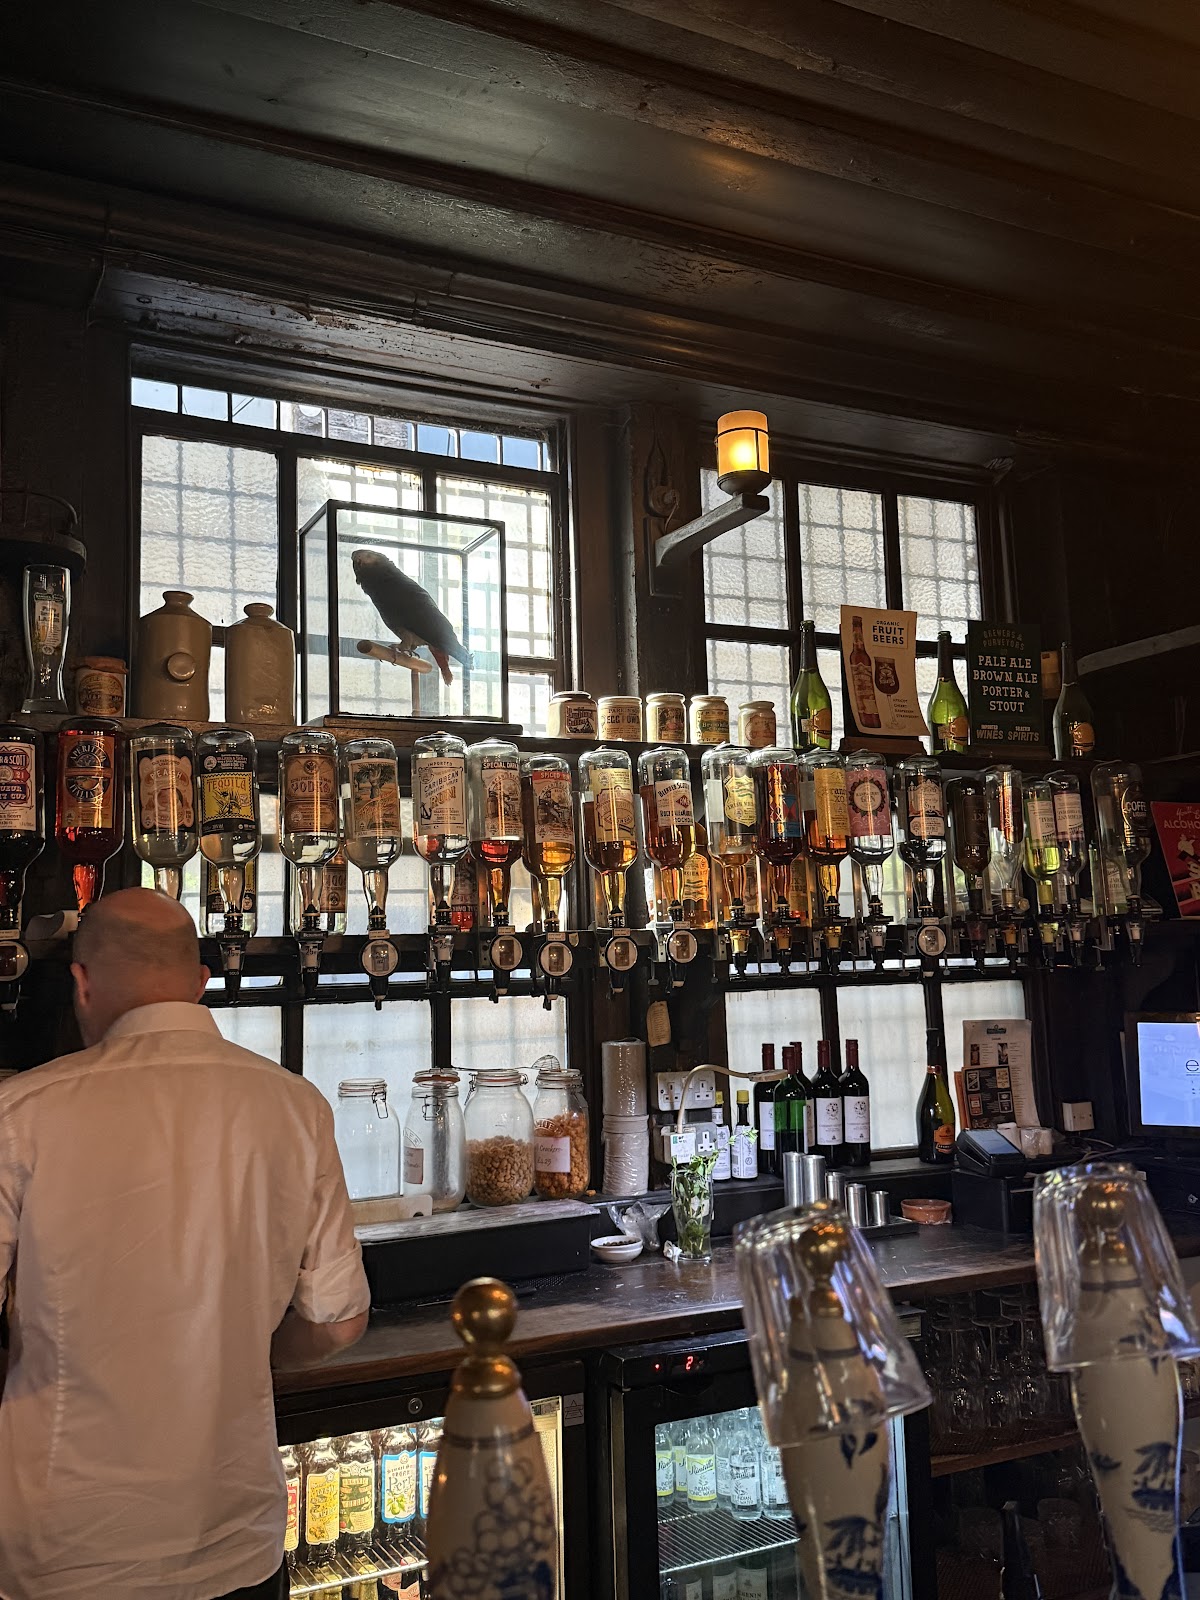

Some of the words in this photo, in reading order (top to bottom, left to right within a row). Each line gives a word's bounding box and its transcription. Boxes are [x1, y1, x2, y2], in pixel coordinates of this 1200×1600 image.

[872, 626, 905, 636] FRUIT
[983, 629, 1016, 639] BREWERS
[1017, 633, 1023, 642] &
[873, 635, 904, 645] BEERS
[982, 638, 1025, 651] PURVEYORS
[978, 655, 1006, 668] PALE
[1009, 657, 1032, 669] ALE
[972, 669, 1013, 682] BROWN
[1015, 672, 1038, 684] ALE
[981, 685, 1023, 698] PORTER
[1024, 690, 1031, 699] &
[989, 700, 1025, 713] STOUT
[607, 715, 620, 724] EGG
[976, 730, 1004, 740] WINES
[1007, 731, 1040, 742] SPIRITS
[207, 779, 246, 792] TEQUILA
[424, 770, 460, 793] CARIBBEAN
[429, 786, 457, 809] RUM
[657, 784, 677, 798] BLENDED
[686, 1355, 694, 1370] 2
